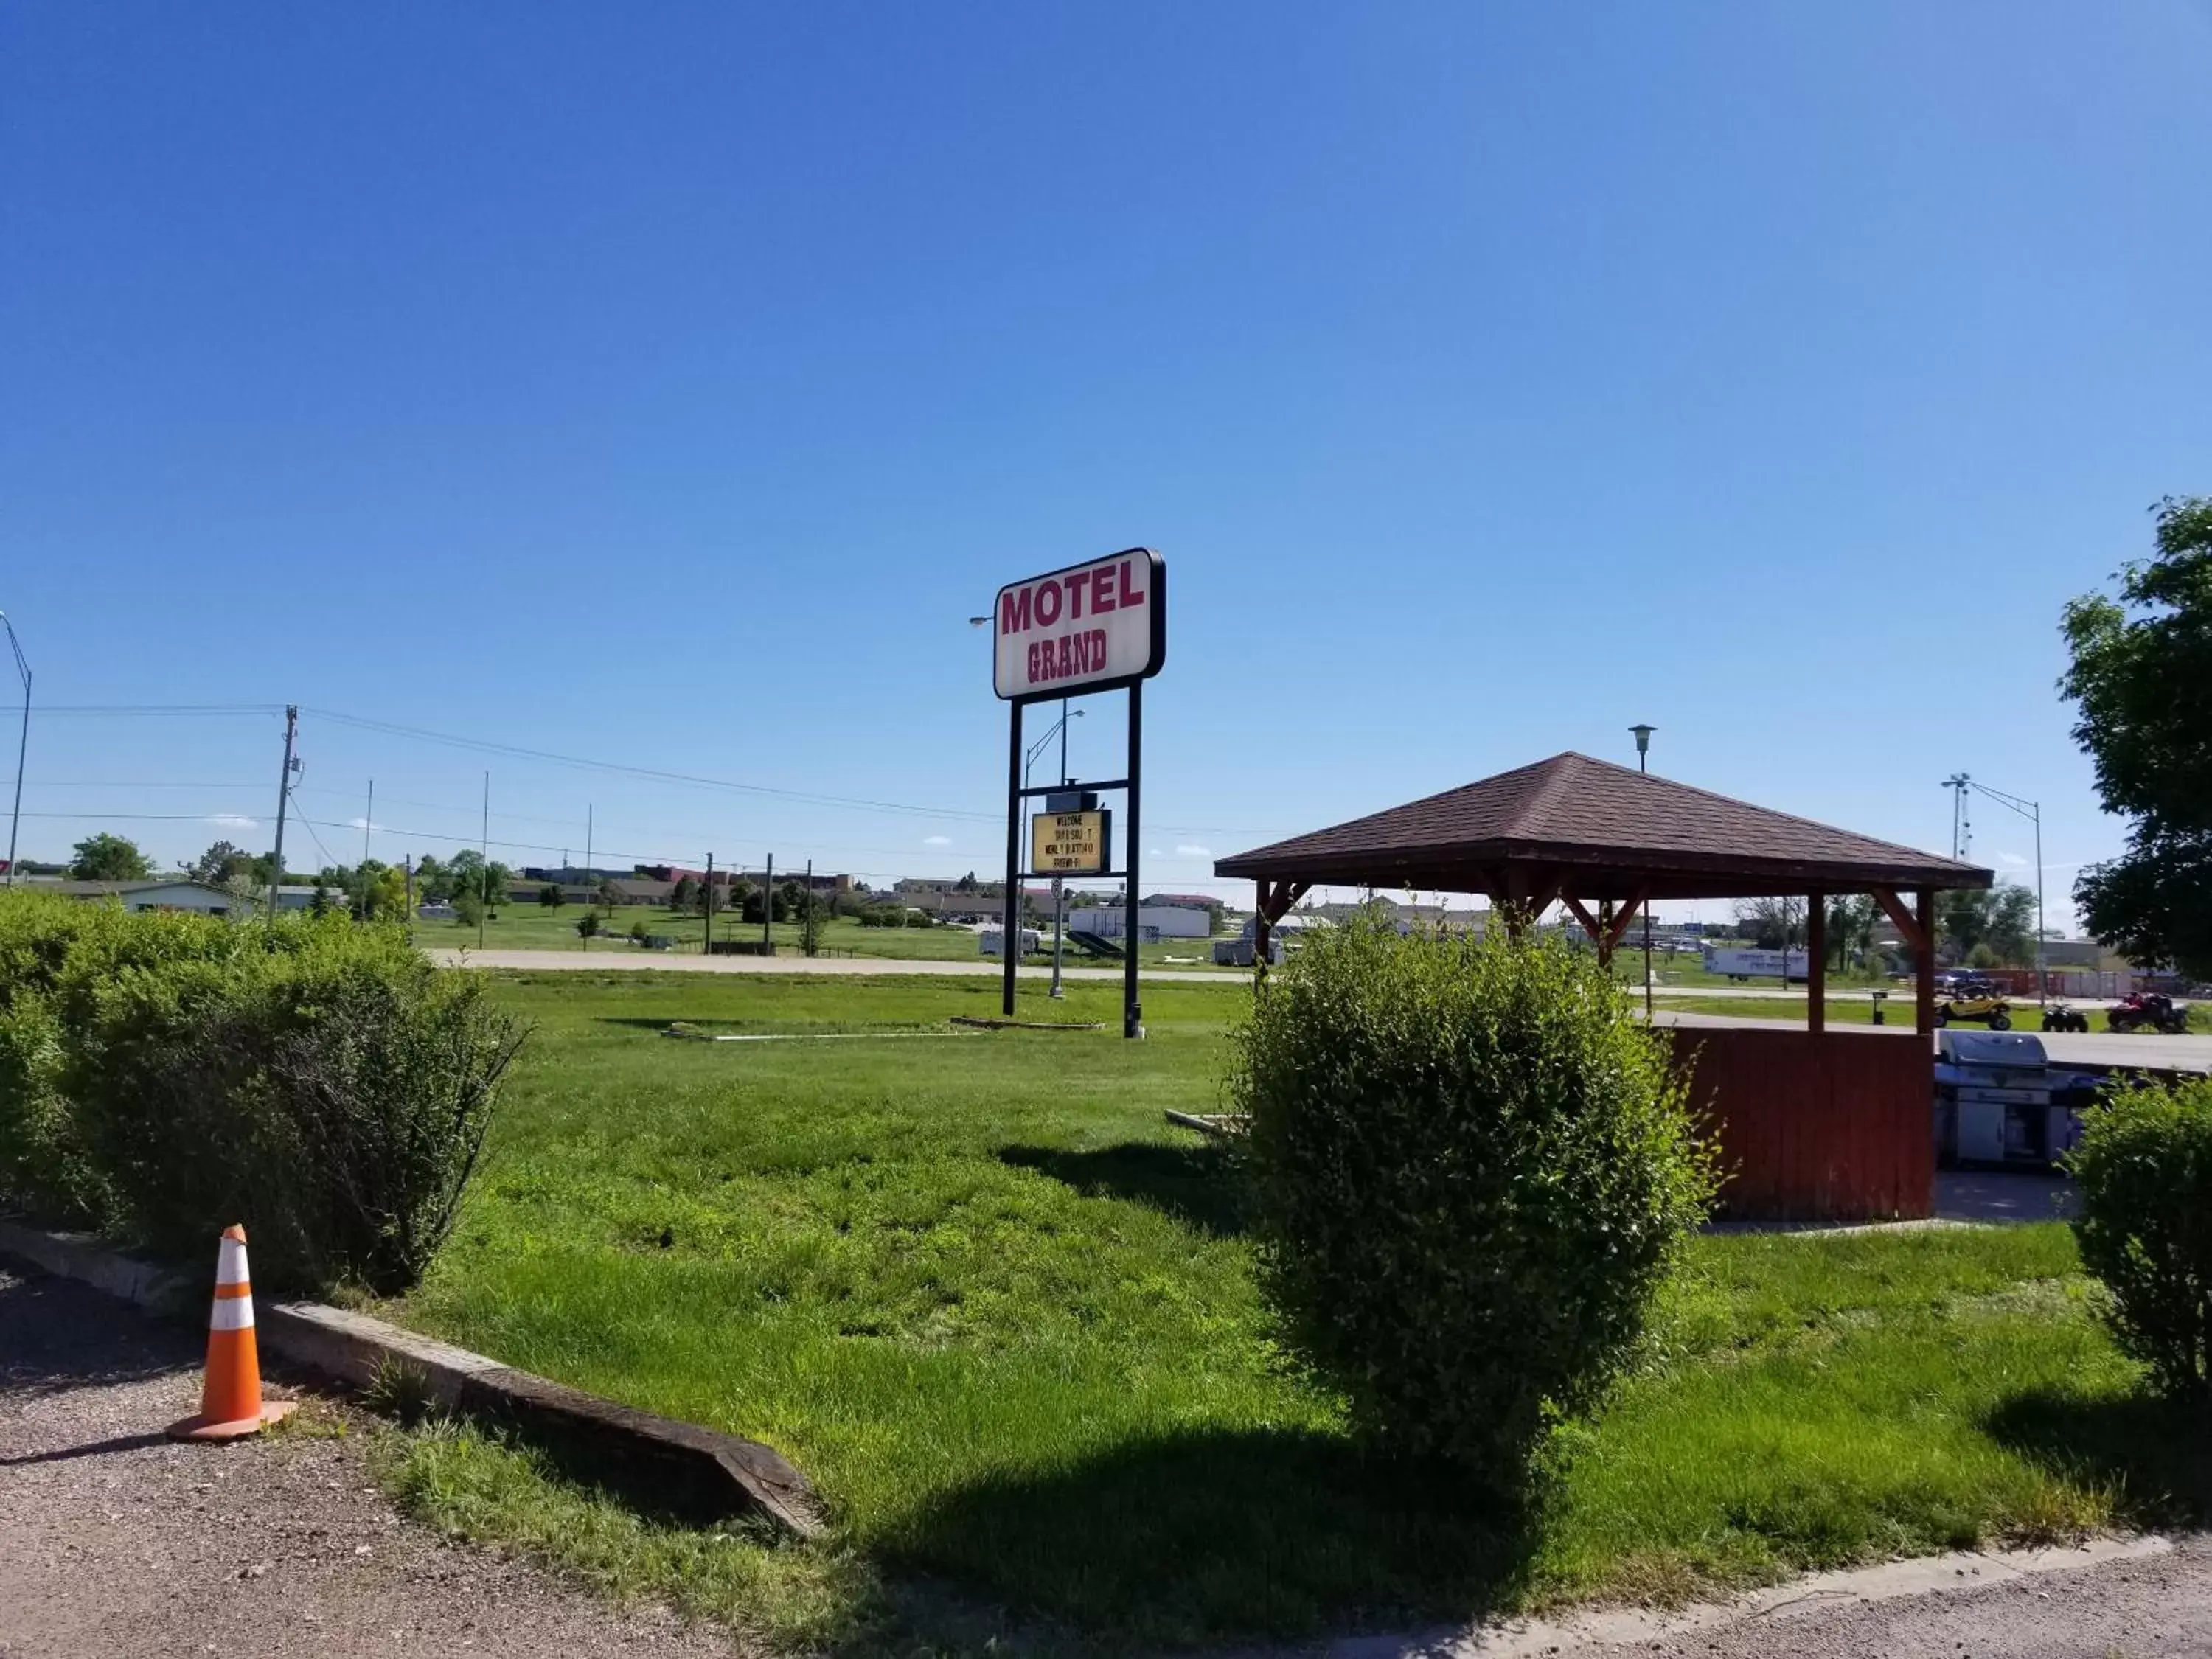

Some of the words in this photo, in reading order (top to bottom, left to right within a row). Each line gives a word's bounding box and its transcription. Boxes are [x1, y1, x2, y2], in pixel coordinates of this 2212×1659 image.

[1001, 560, 1145, 636] MOTEL
[1027, 628, 1107, 684] GRAND
[1057, 815, 1083, 827] WELCOME
